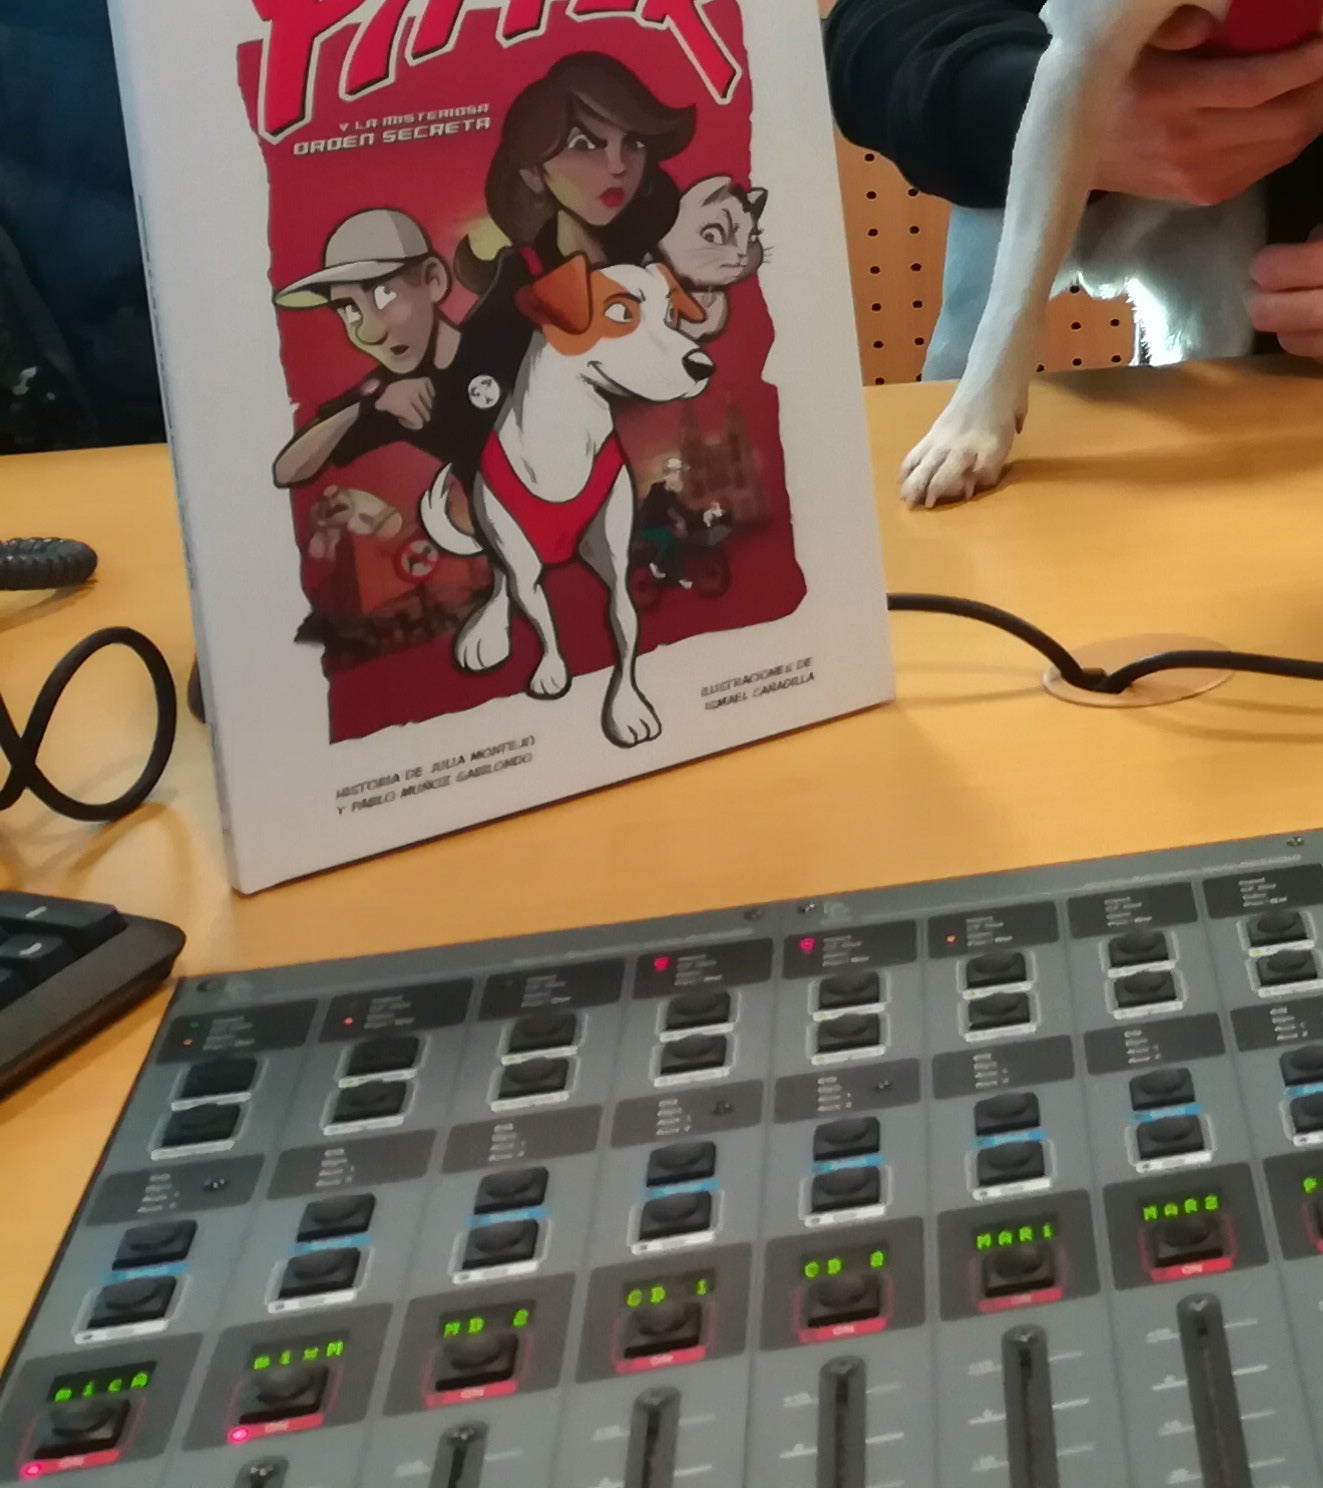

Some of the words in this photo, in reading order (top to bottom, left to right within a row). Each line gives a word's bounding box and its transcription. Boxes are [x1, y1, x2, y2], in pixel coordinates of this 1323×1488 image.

[355, 118, 378, 131] LA
[382, 103, 490, 127] MISTERIOSA
[293, 133, 376, 156] ORDEN
[383, 116, 492, 144] SECRETA
